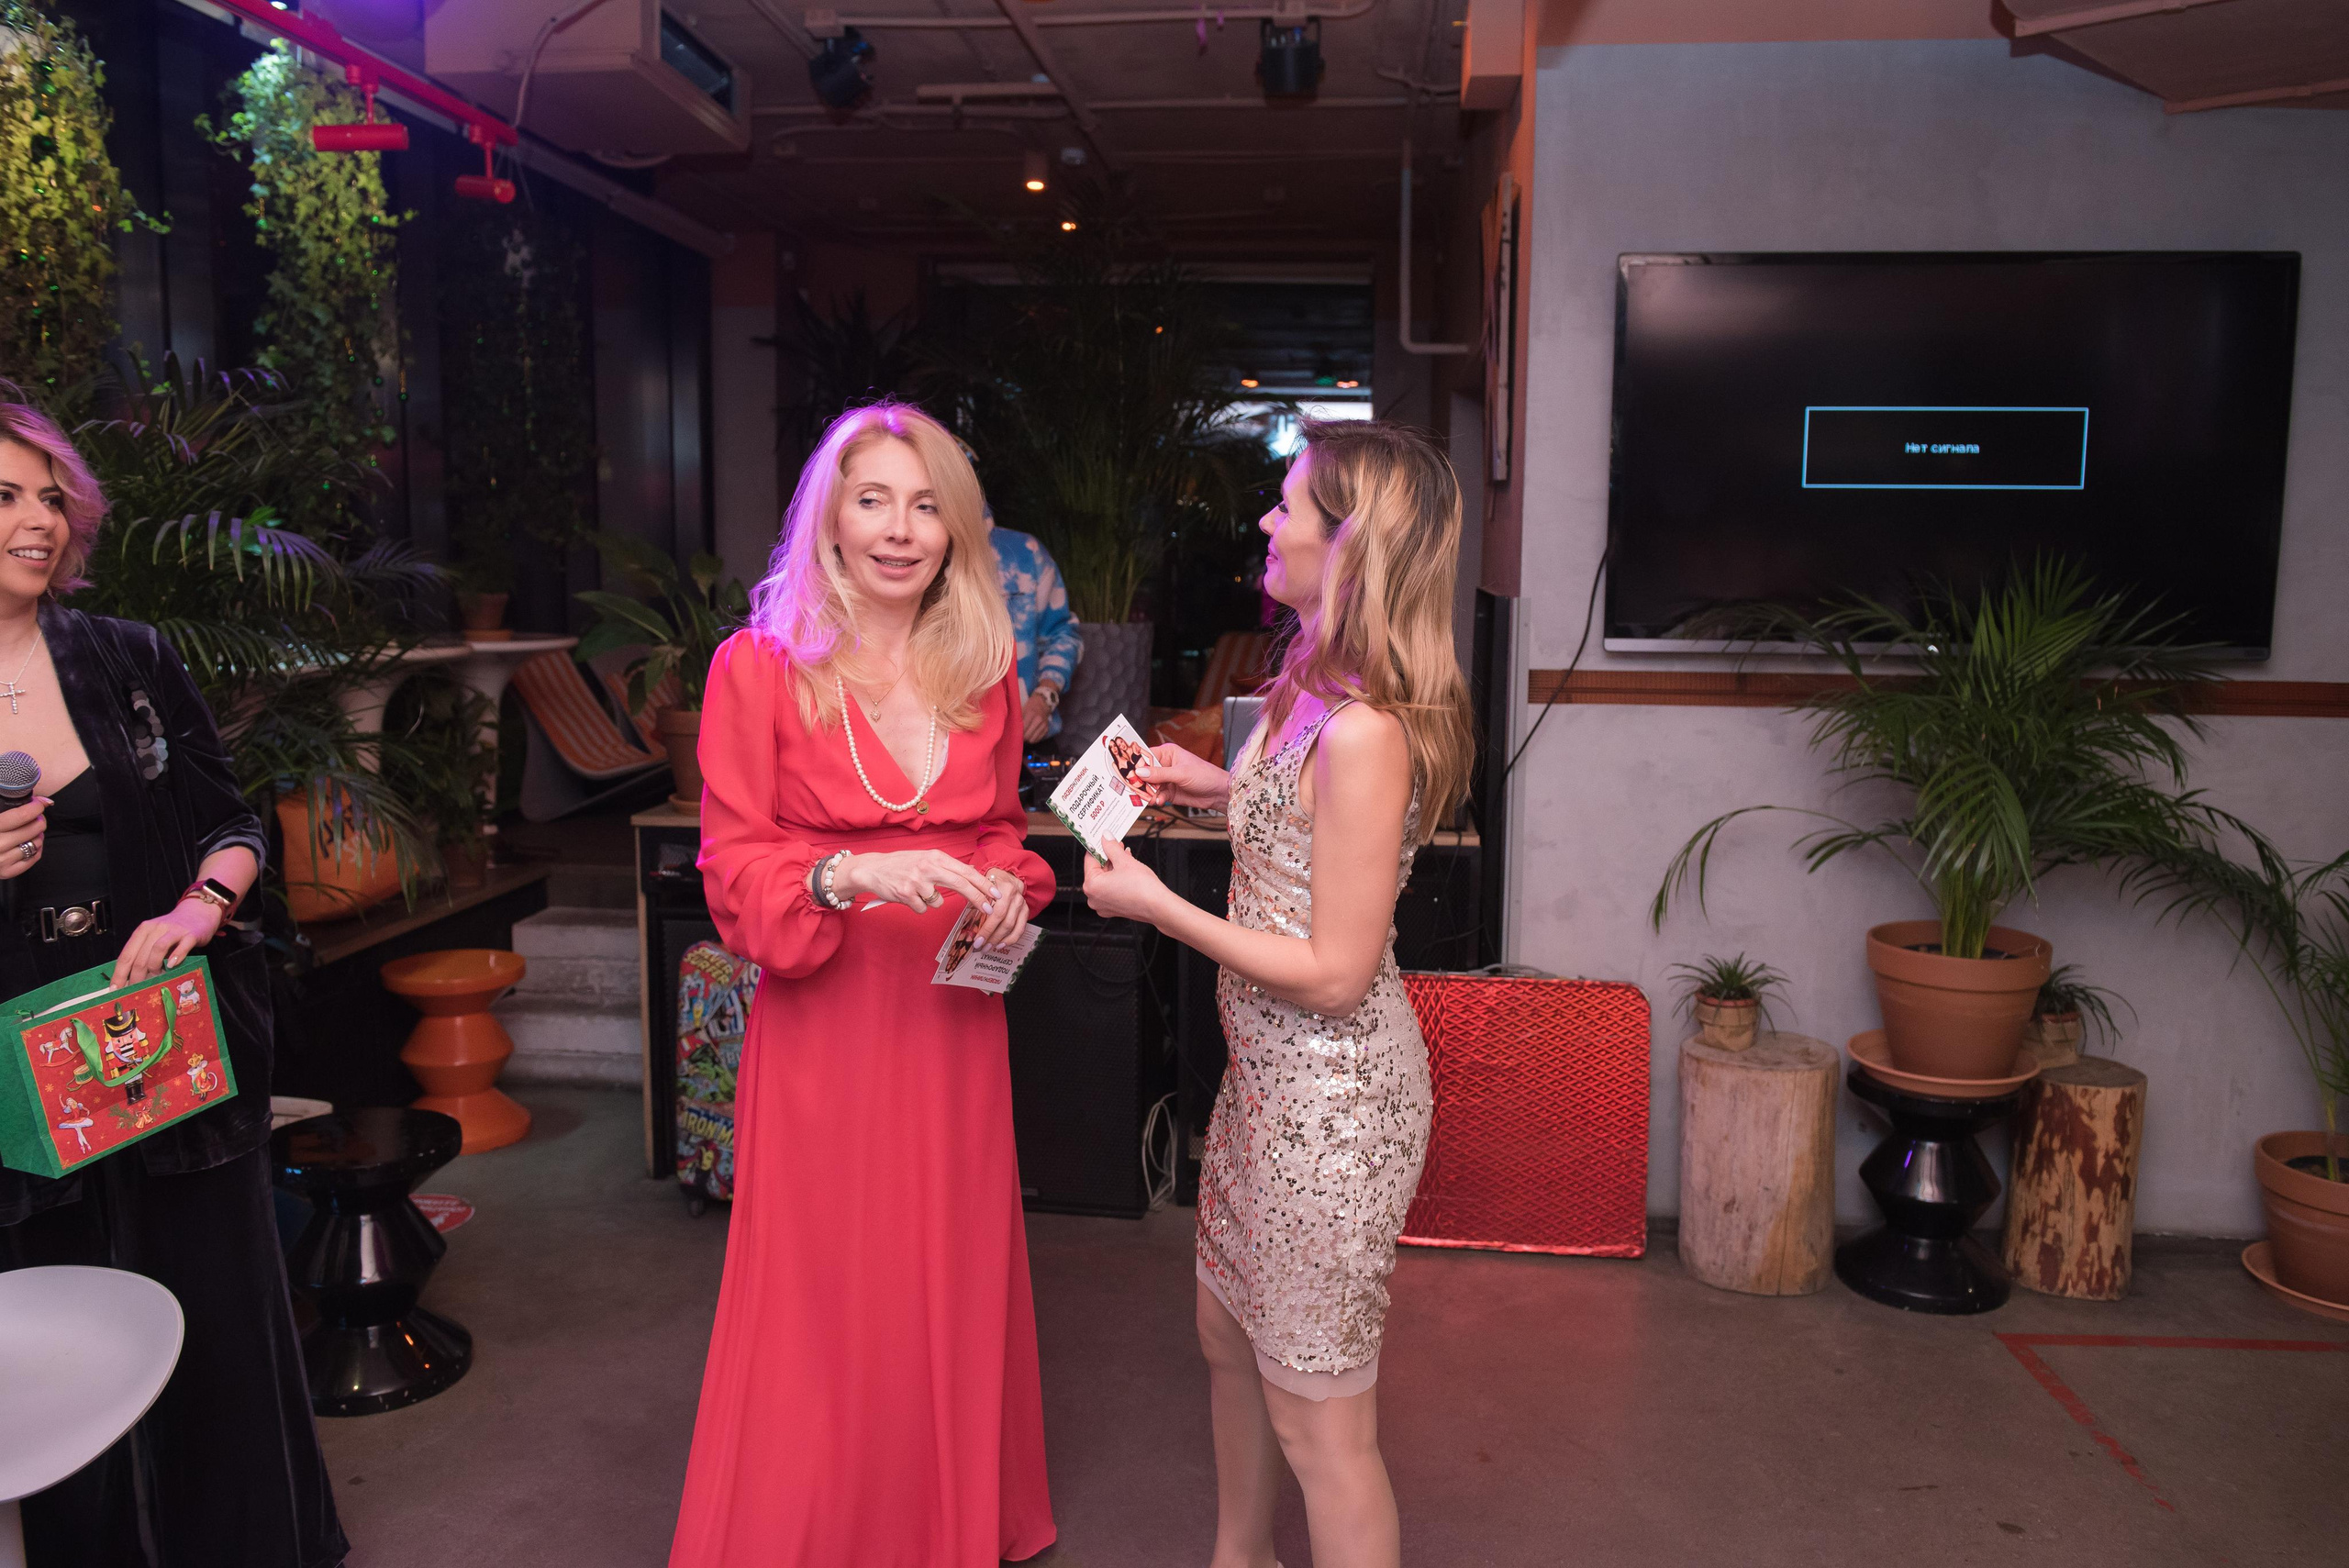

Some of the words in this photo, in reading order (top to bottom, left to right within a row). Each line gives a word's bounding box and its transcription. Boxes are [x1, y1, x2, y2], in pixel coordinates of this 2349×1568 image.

[1904, 442, 1928, 454] Нет
[1930, 443, 1980, 454] сигнала
[1069, 774, 1100, 814] ПОДАРОЧНЫЙ
[1077, 784, 1106, 820] СЕРТИФИКАТ
[1090, 806, 1102, 820] 5000
[980, 954, 1013, 966] СЕРТИФИКАТ
[974, 962, 1010, 974] ПОДАРОЧНЫЙ
[681, 1110, 717, 1140] IRON
